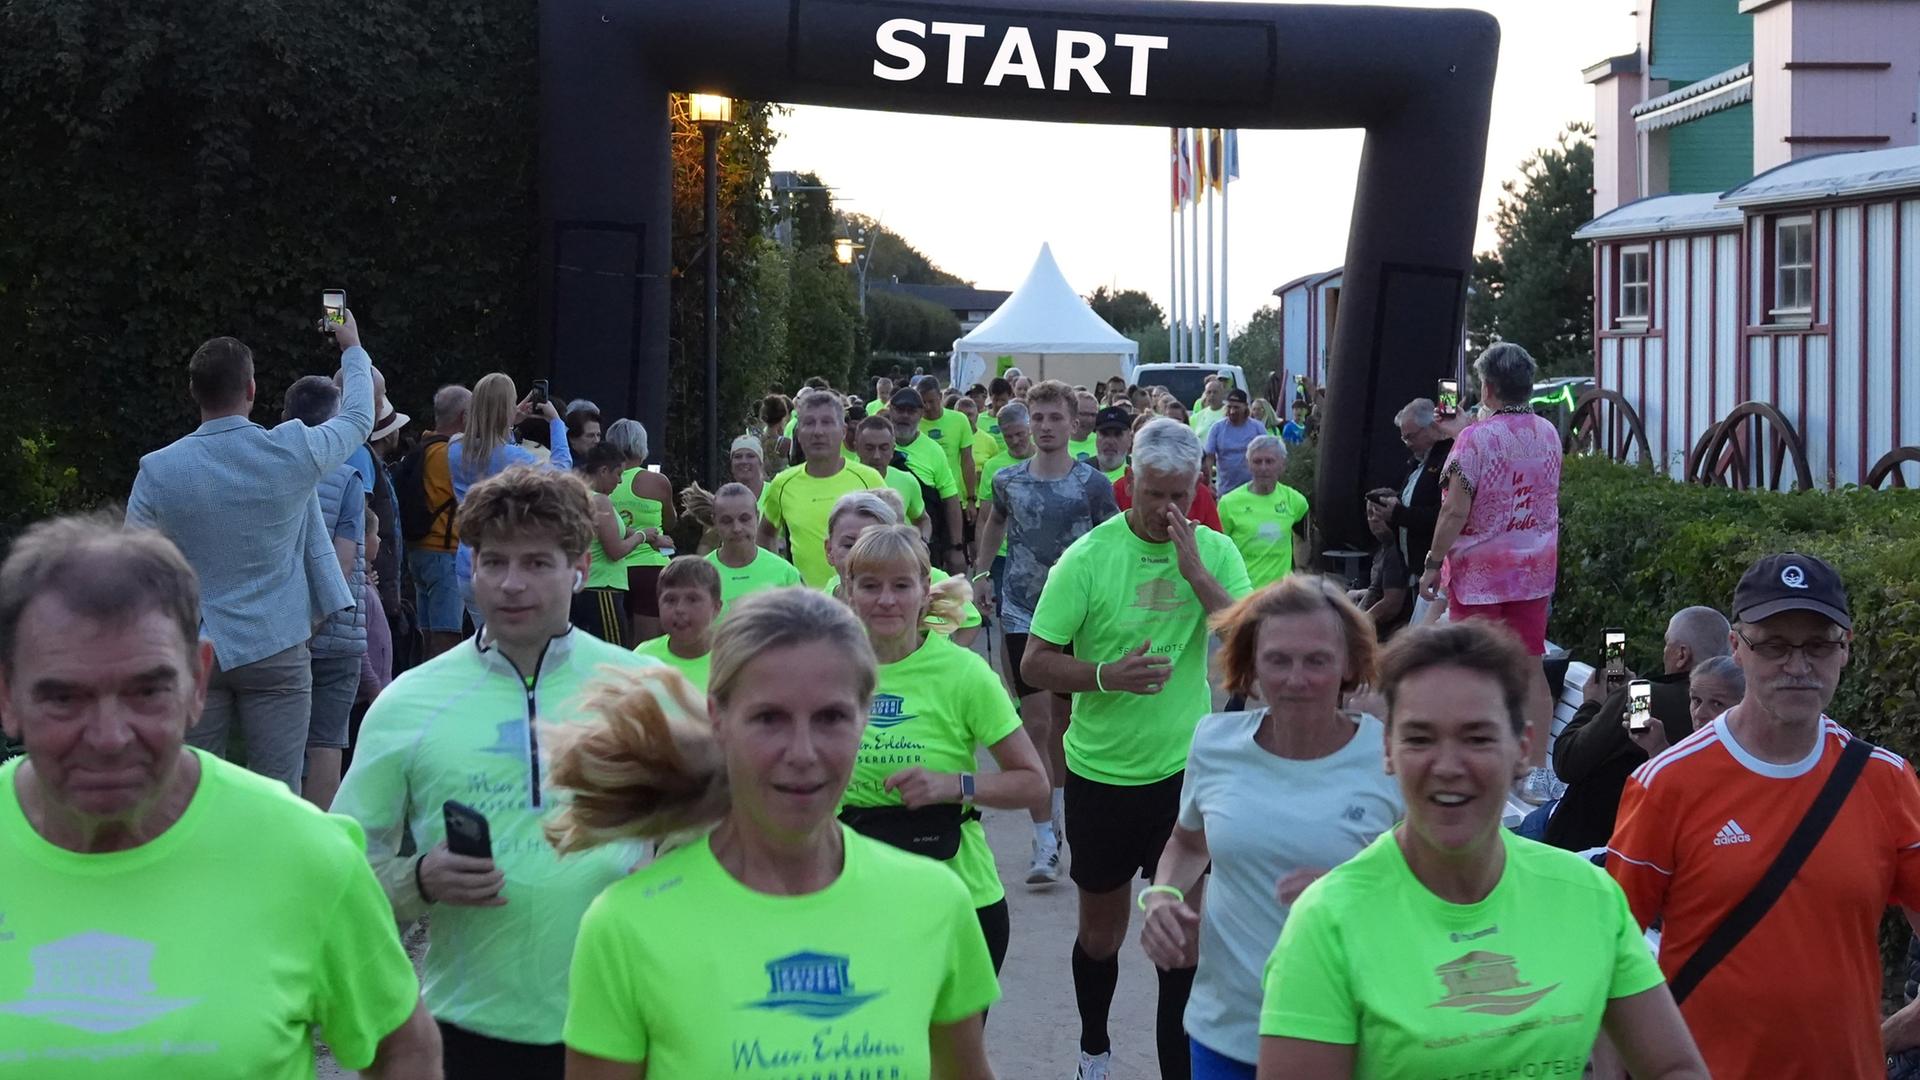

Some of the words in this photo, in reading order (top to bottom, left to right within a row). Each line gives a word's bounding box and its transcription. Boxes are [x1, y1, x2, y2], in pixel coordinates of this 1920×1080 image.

[873, 18, 1169, 96] START
[1506, 514, 1537, 532] belle
[874, 732, 925, 750] Erleben.
[858, 753, 926, 765] SERBÄDER.
[1713, 833, 1751, 846] adidas
